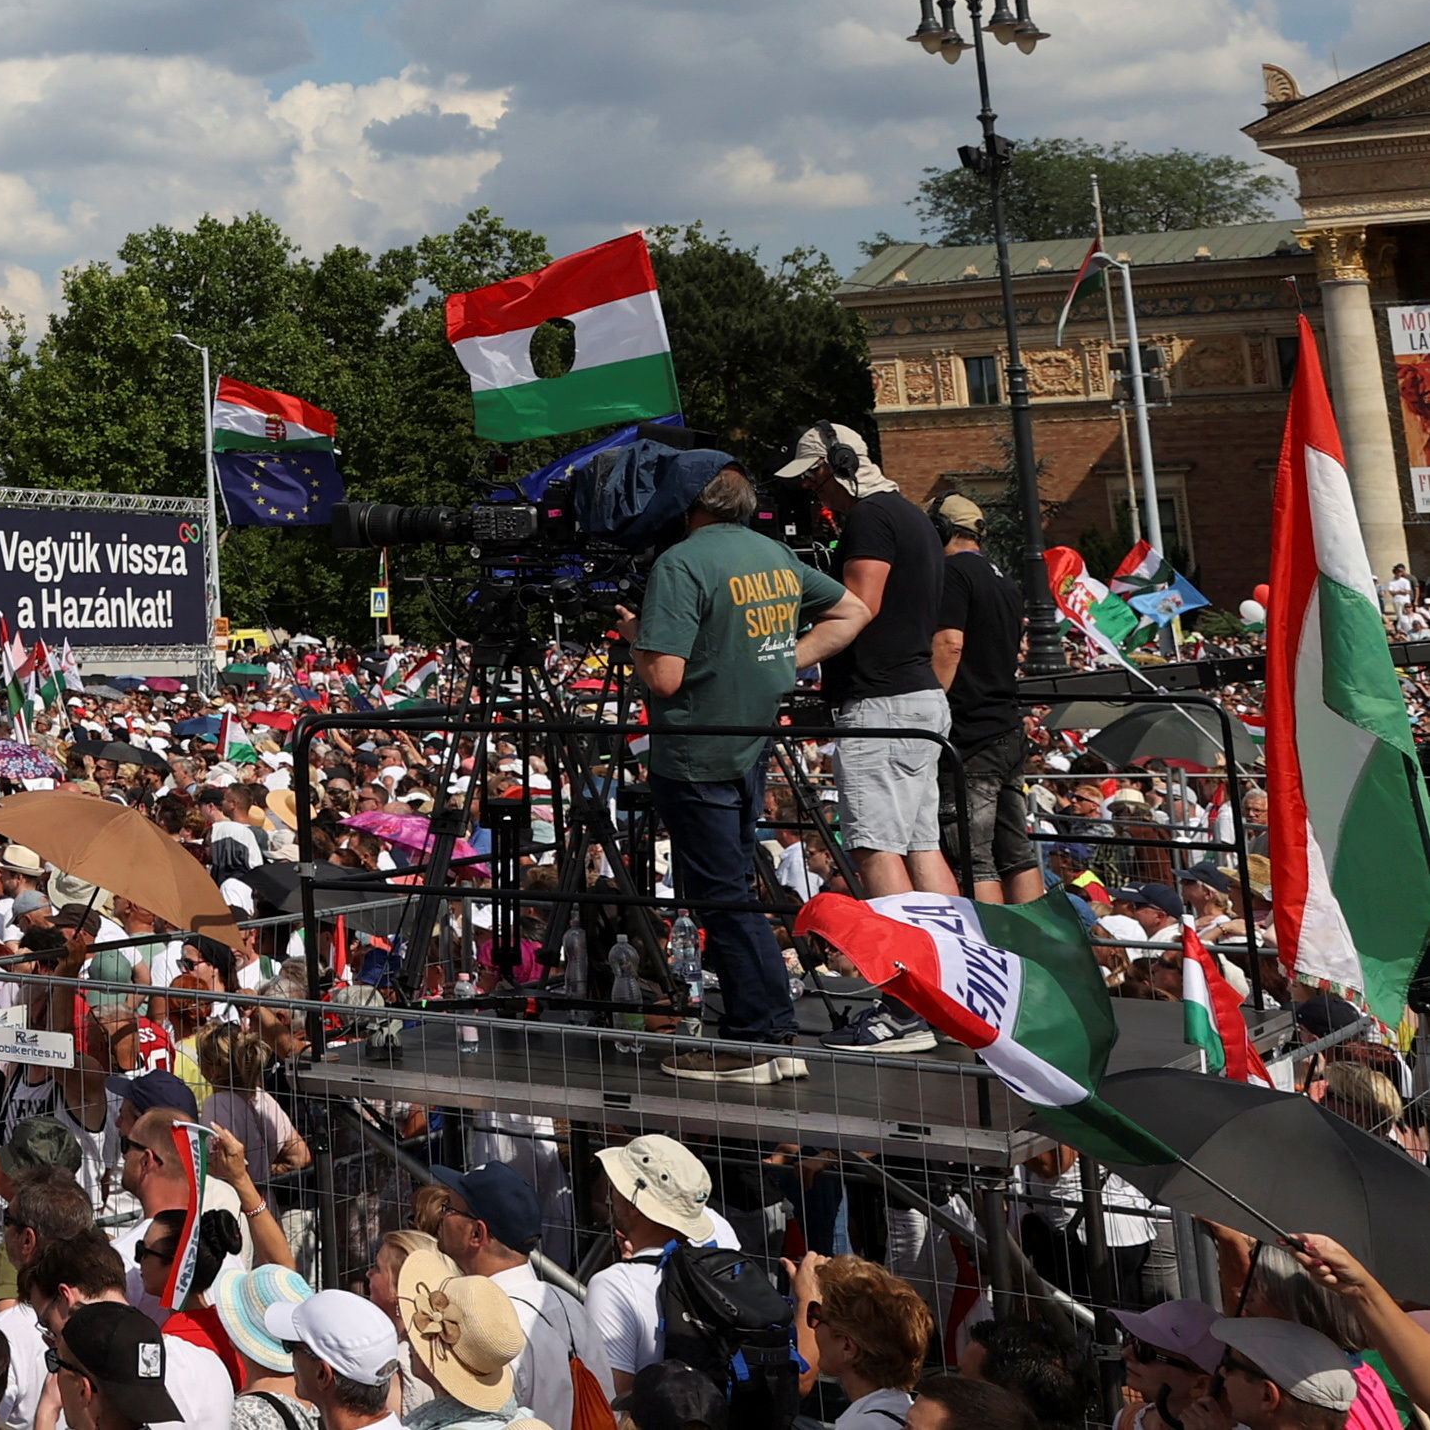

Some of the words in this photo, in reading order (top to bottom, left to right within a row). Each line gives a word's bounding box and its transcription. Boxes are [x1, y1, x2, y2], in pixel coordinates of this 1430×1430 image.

[1401, 312, 1430, 331] MO
[105, 533, 188, 576] vissza
[17, 596, 36, 629] a
[41, 587, 173, 629] Hazánkat!
